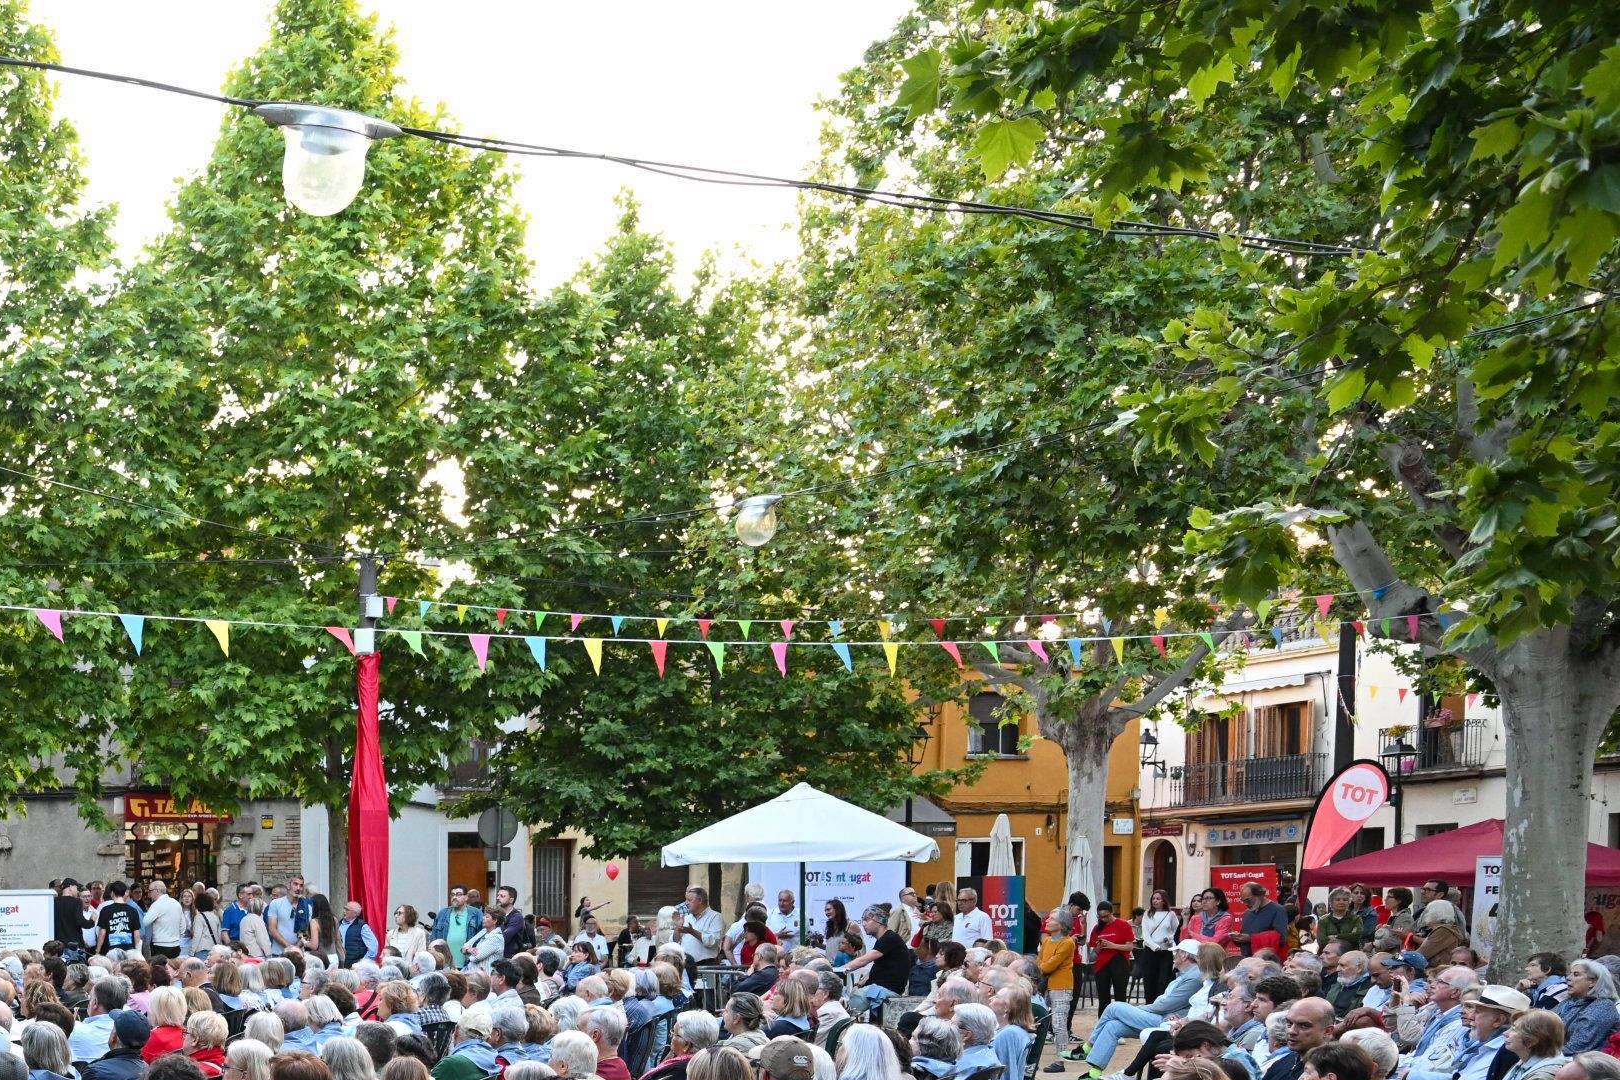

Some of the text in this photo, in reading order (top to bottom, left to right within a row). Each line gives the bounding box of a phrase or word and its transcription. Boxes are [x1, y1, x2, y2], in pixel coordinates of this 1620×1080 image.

[1342, 783, 1379, 805] TOT
[1222, 827, 1281, 841] La Granja
[805, 872, 821, 882] OT
[112, 911, 127, 919] ANTI
[988, 904, 1018, 919] TOT
[109, 917, 130, 926] SOCIAL
